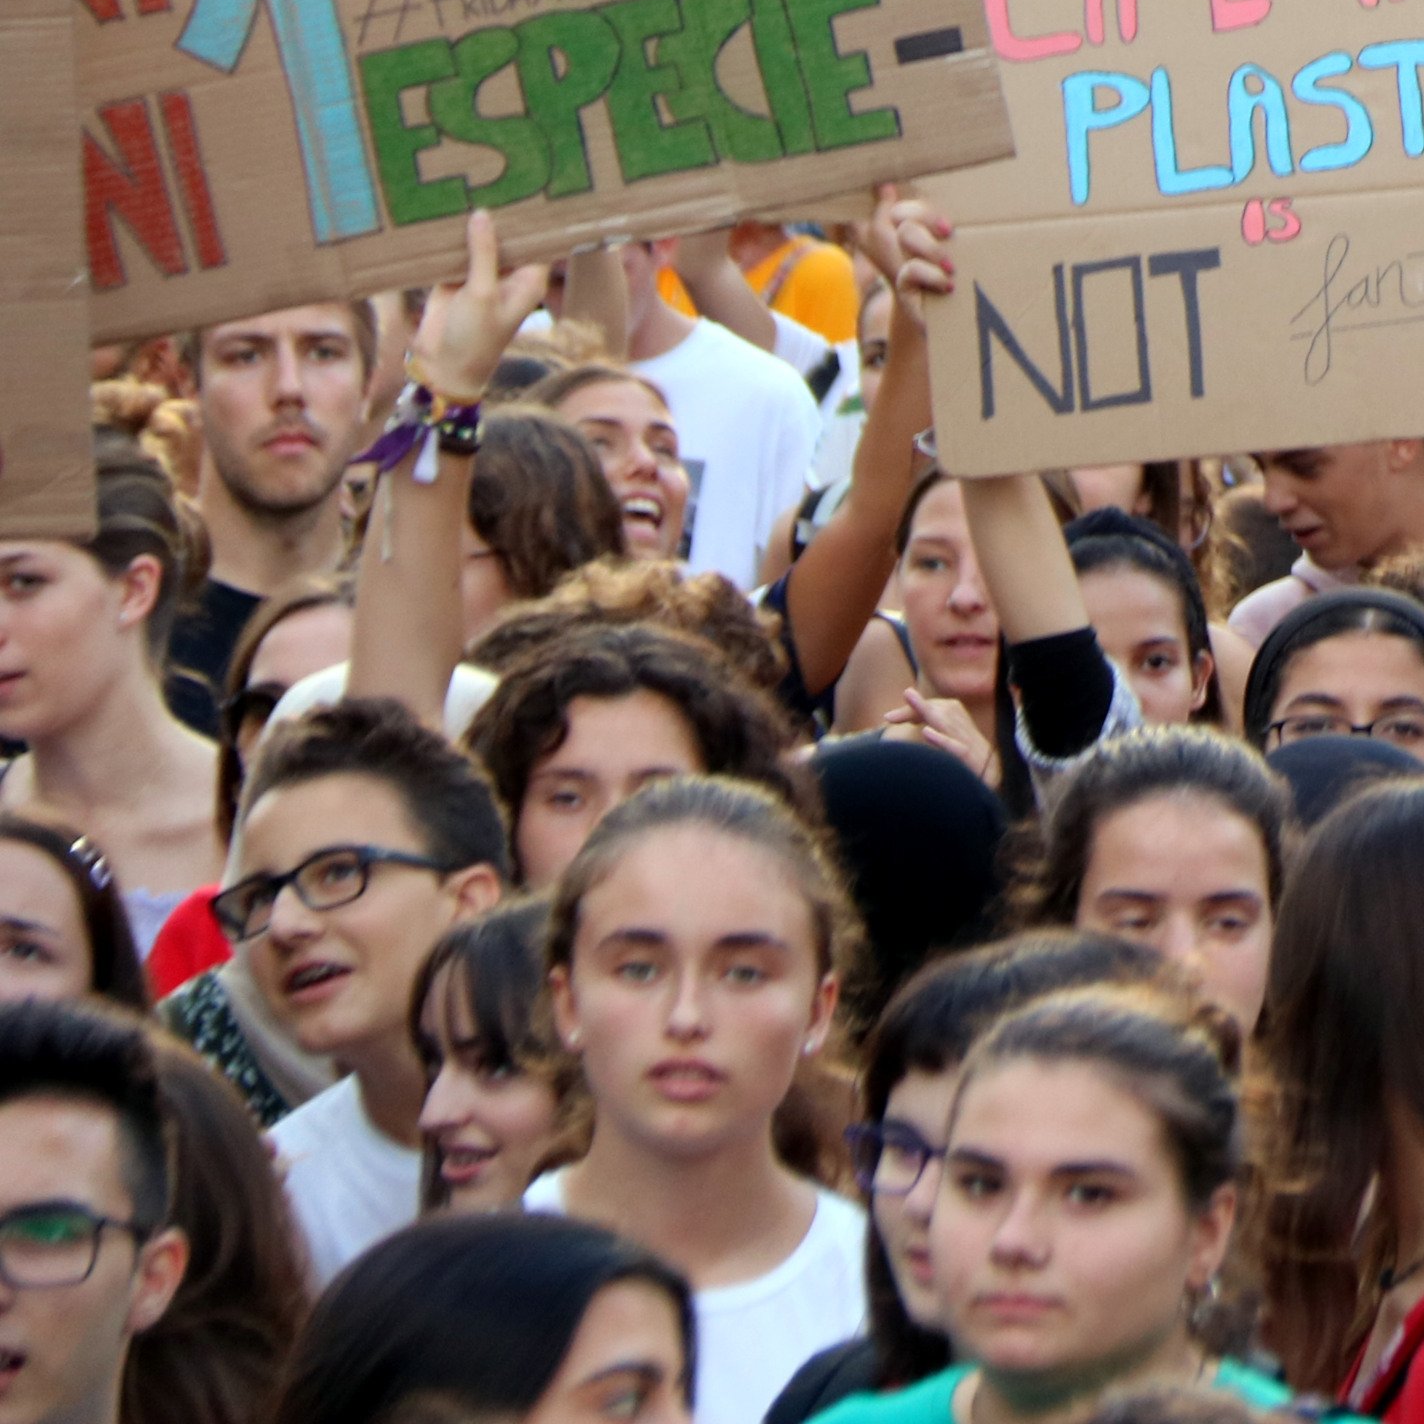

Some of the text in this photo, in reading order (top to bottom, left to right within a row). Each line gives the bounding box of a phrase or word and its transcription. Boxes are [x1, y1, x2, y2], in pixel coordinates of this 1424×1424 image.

[83, 88, 229, 294] NI
[1240, 196, 1303, 247] IS
[973, 247, 1222, 422] NOT
